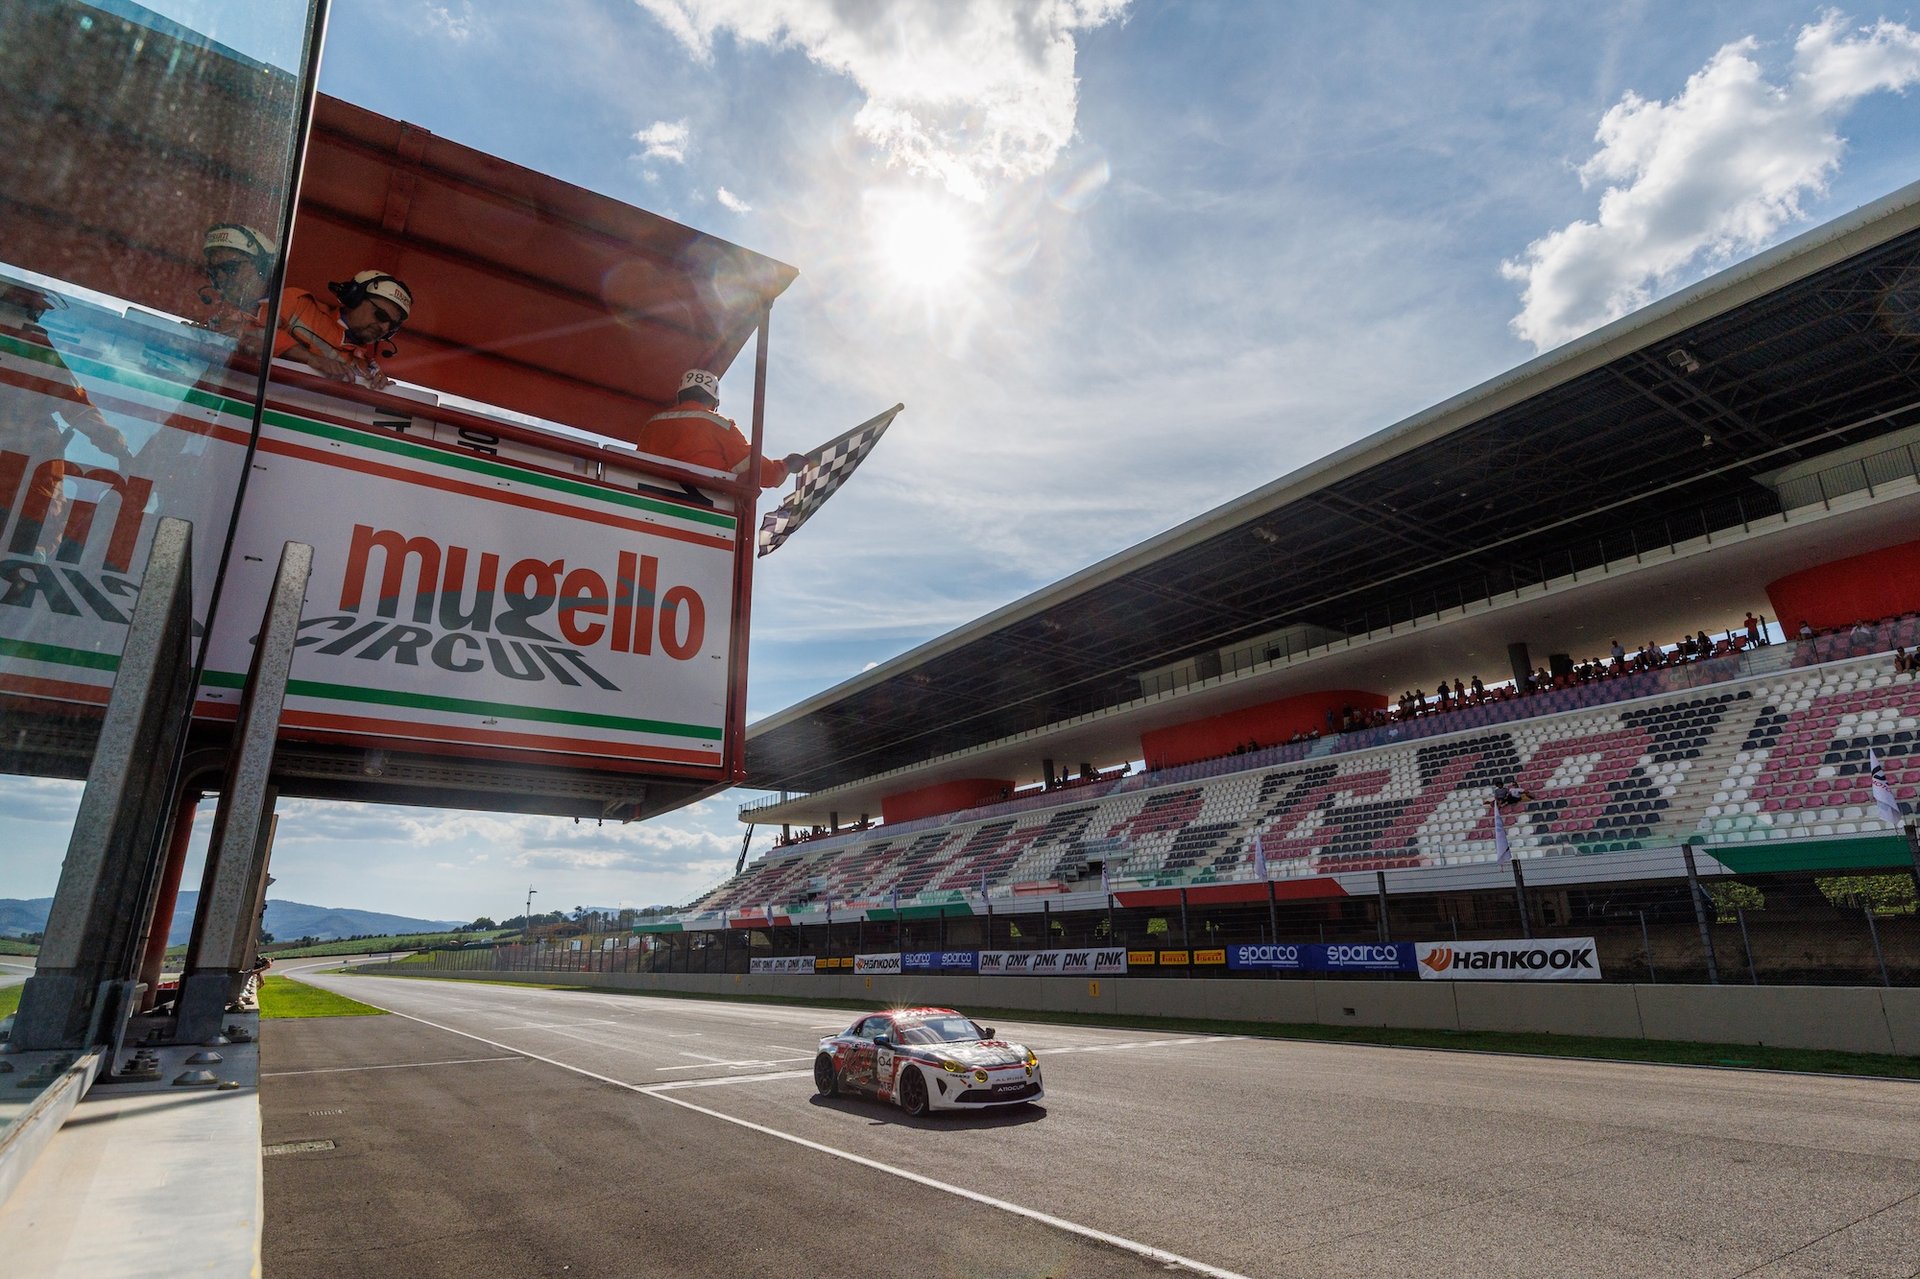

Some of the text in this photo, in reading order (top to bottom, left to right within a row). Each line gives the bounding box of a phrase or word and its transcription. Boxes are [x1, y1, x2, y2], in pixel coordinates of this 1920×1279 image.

[686, 372, 713, 388] 982
[339, 524, 706, 661] mugello
[249, 616, 622, 692] CIRCUIT
[941, 952, 972, 966] sparco
[1239, 946, 1298, 965] sparco
[1327, 945, 1398, 966] sparco
[878, 1055, 892, 1067] 04
